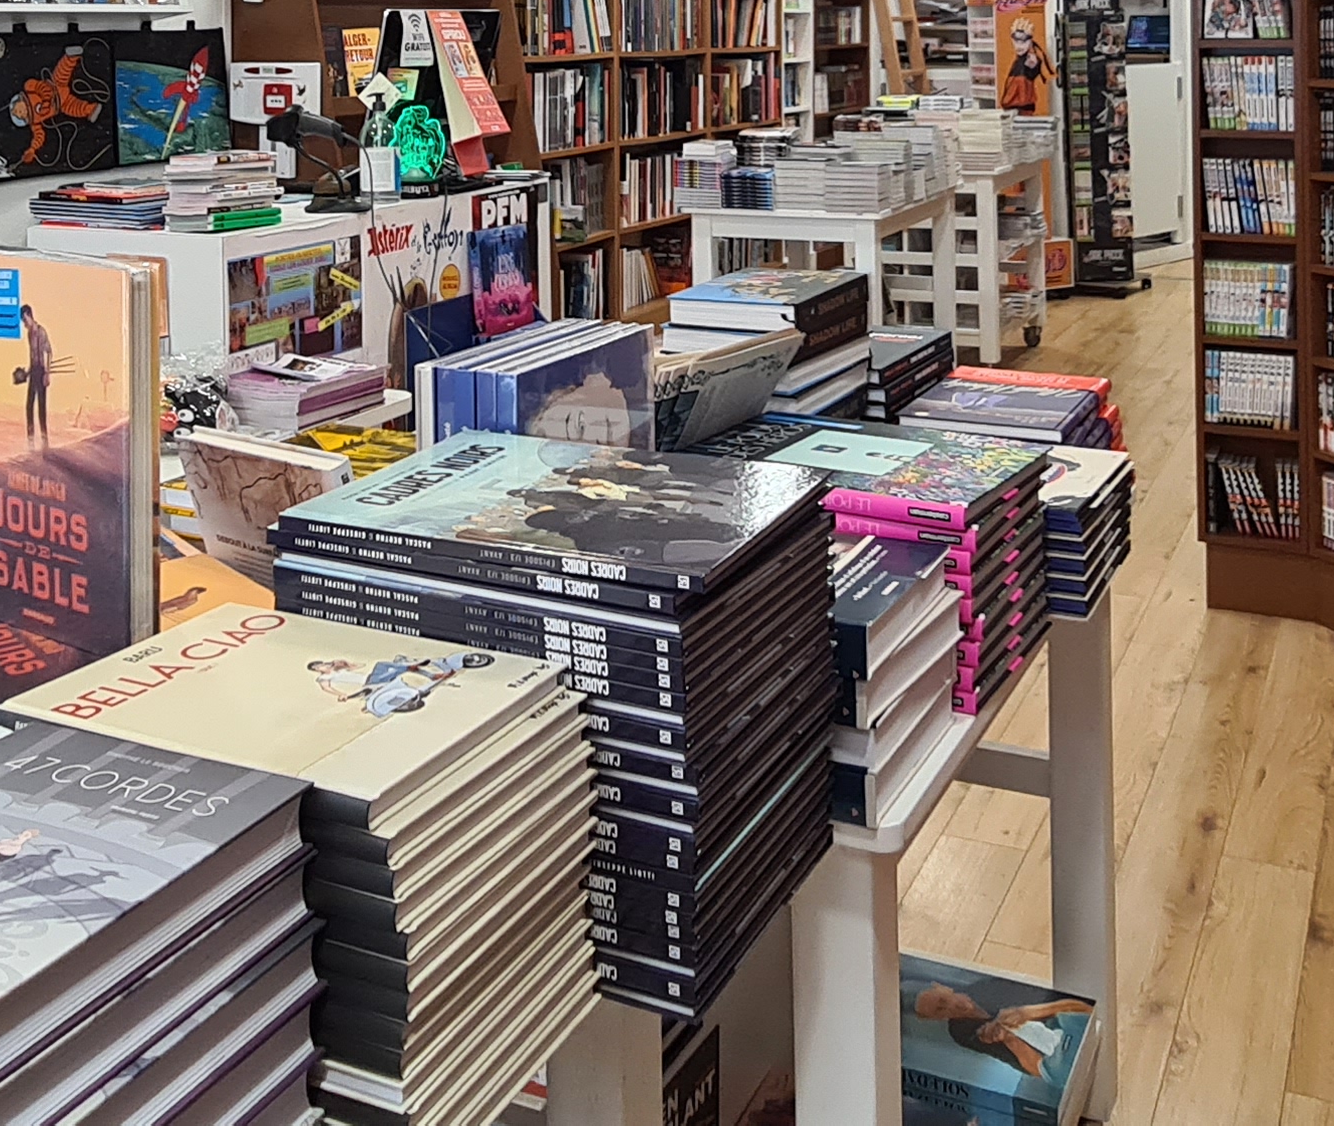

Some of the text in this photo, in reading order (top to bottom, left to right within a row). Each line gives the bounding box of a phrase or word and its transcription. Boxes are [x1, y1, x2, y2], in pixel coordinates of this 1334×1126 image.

[481, 193, 528, 230] PFM
[355, 444, 506, 507] CADRES NOIRS
[24, 541, 52, 560] DE
[562, 557, 626, 580] CADRES NOIRS
[537, 575, 599, 599] CADRES NOIRS
[544, 616, 607, 641] CADRES NOIRS
[122, 644, 164, 665] BARU
[544, 634, 607, 657] CADRES NOIRS
[51, 614, 288, 721] BELLA CIAO
[3, 754, 63, 776] 47
[51, 762, 231, 819] CORDES
